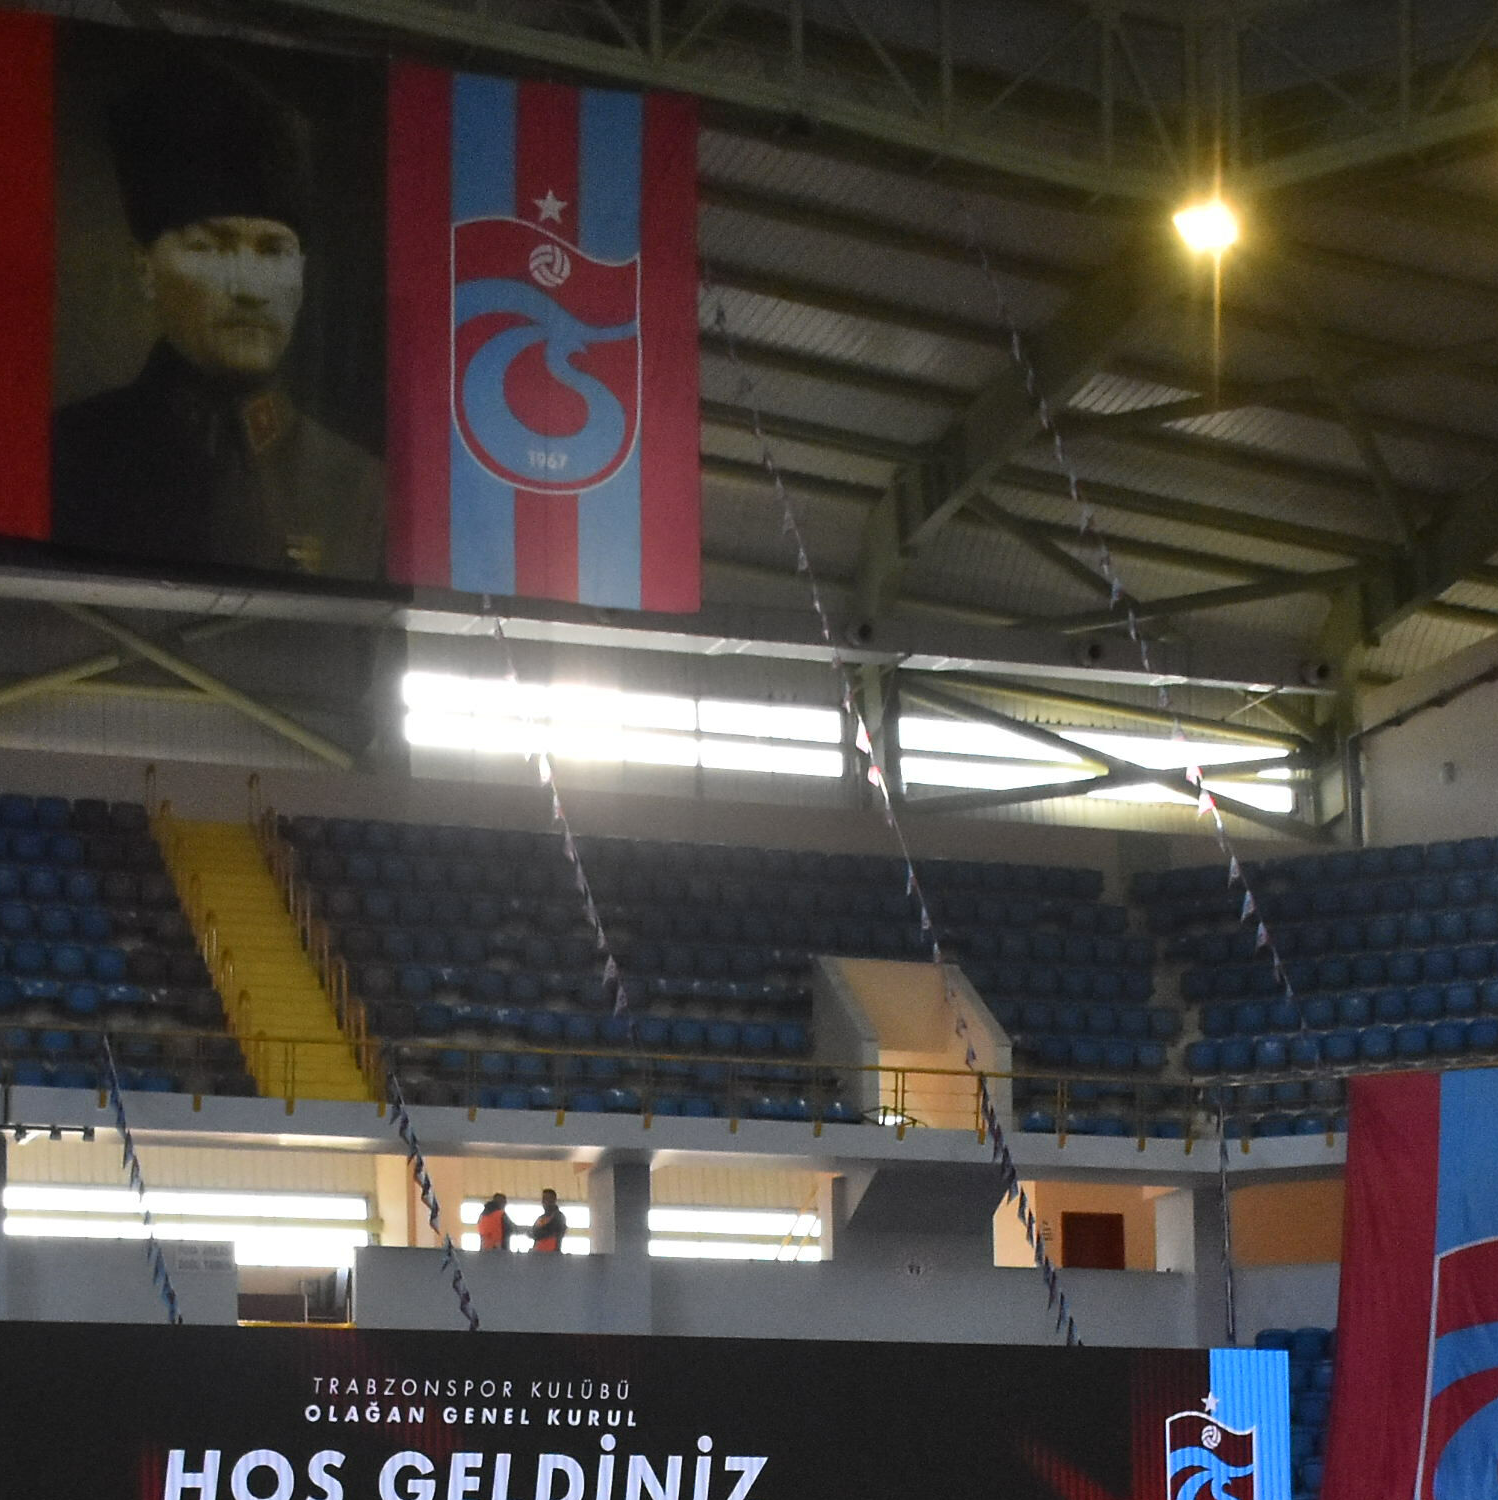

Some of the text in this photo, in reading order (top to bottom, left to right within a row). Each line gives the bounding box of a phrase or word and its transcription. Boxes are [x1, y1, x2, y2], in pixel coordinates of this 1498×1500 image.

[314, 1377, 630, 1400] TRABZONSPOR KULÜBÜ
[304, 1401, 637, 1427] OLAĞAN GENEL KURUL
